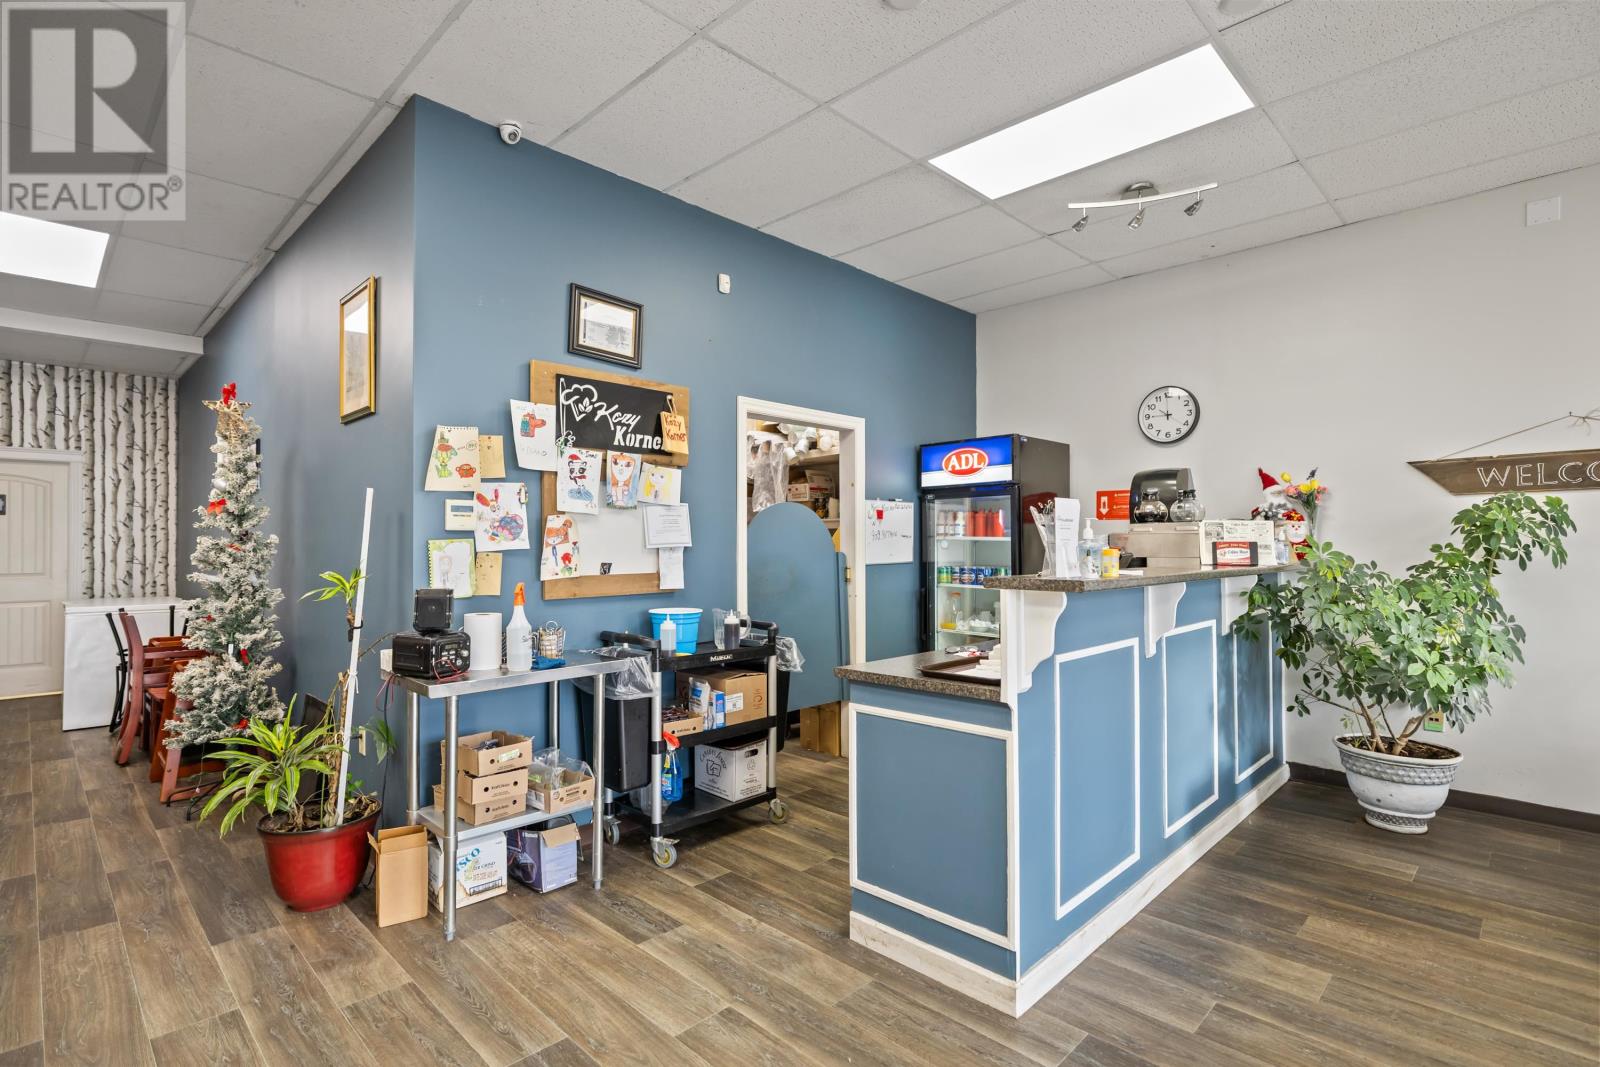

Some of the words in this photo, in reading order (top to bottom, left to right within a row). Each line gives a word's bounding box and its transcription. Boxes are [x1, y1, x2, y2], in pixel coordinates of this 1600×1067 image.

[594, 402, 641, 432] Kozy
[613, 425, 662, 450] Korne
[947, 452, 985, 472] ADL
